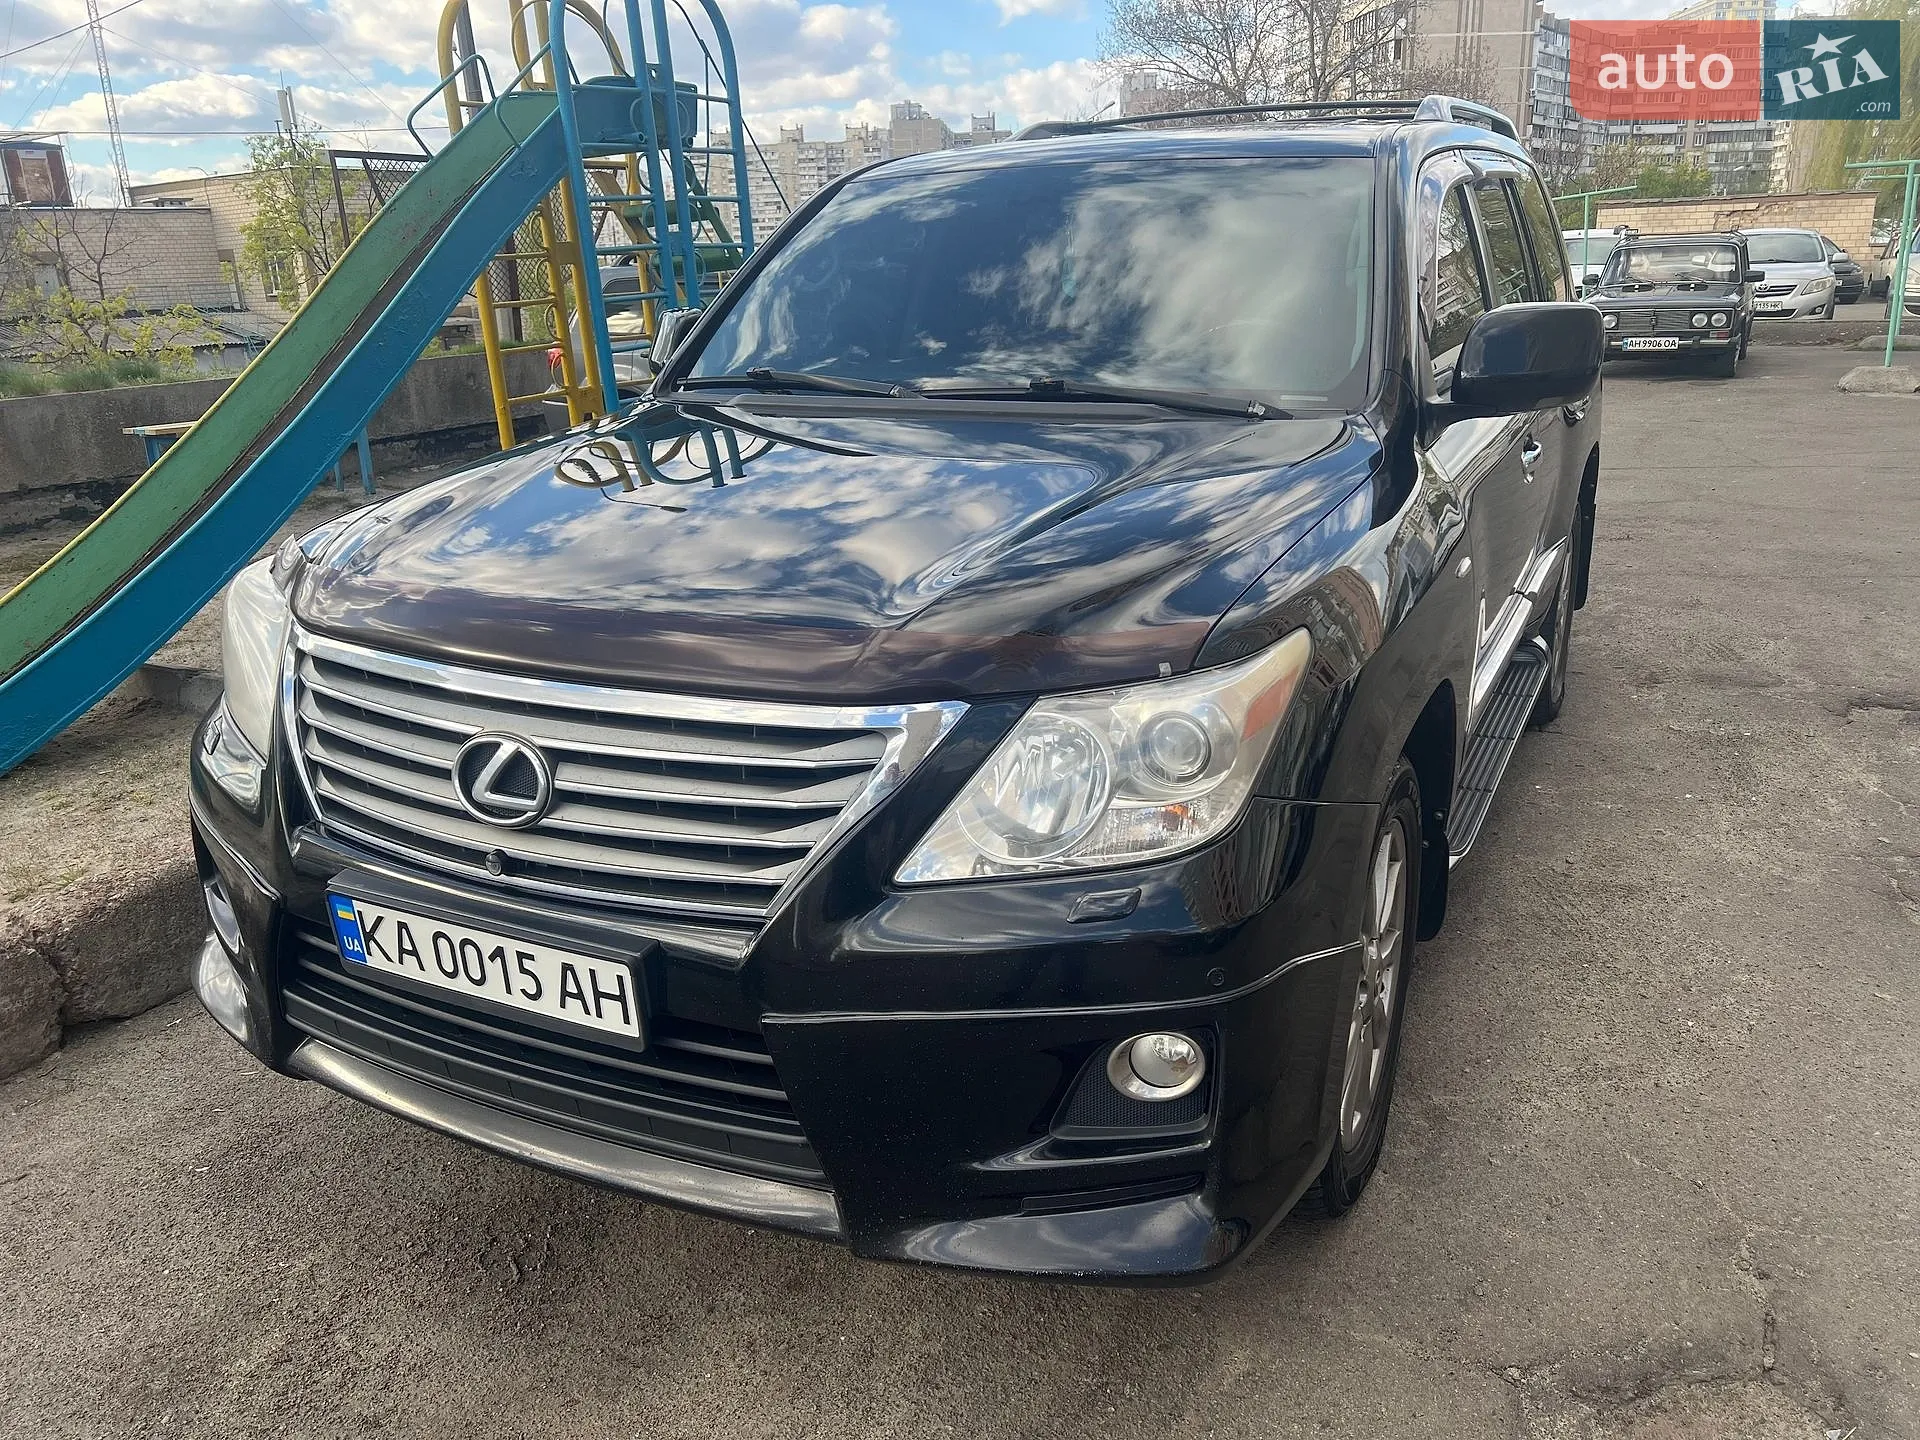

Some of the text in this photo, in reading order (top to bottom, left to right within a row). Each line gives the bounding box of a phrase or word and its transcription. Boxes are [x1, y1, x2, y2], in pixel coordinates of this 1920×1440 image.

[1628, 339, 1677, 348] AH 9906 OA
[343, 935, 363, 954] UA
[357, 909, 632, 1026] KA 0015 AH
